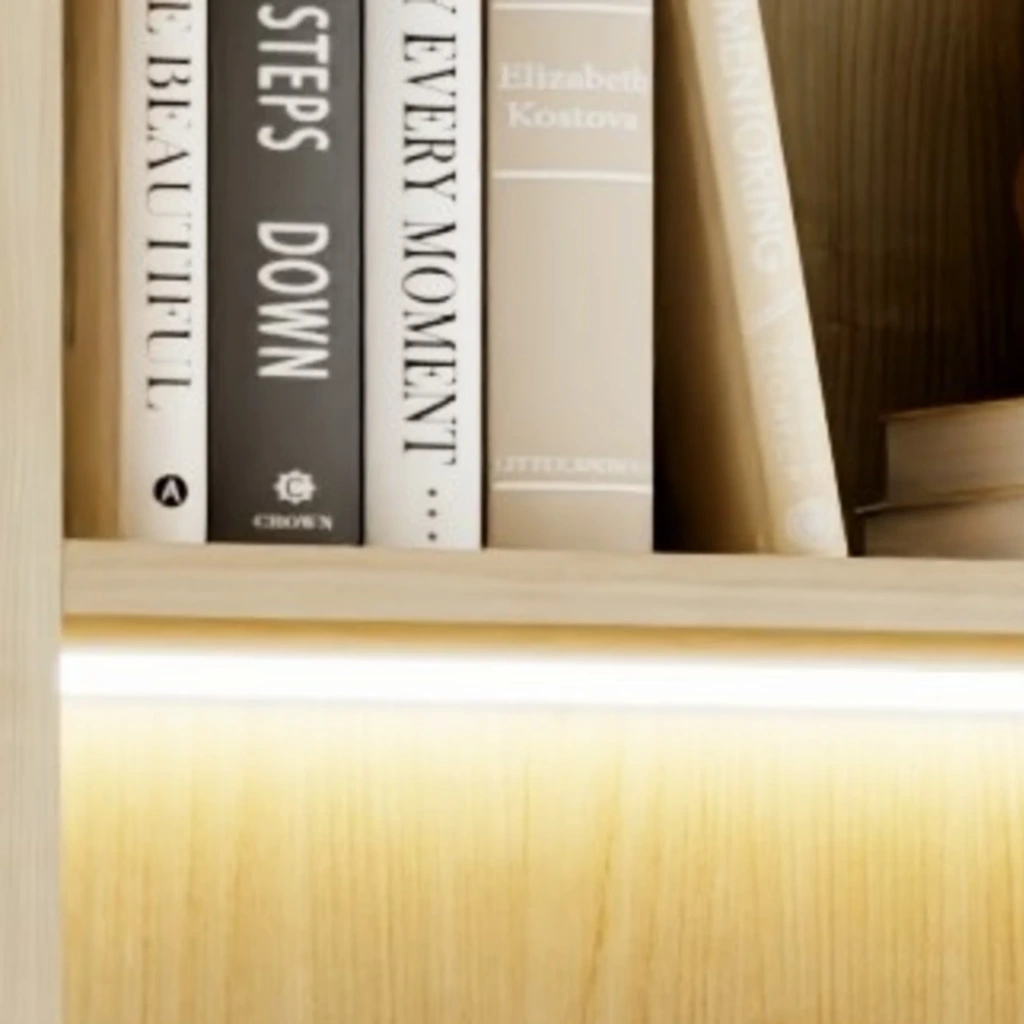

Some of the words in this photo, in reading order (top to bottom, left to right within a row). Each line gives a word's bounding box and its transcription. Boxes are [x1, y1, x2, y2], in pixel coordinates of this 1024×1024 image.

[257, 4, 330, 152] STEPS
[402, 33, 457, 202] EVERY
[499, 61, 648, 97] Elizabeth
[506, 101, 638, 131] Kostova
[714, 0, 791, 273] MENTORING
[146, 56, 192, 411] BEAUTIFUL
[257, 222, 330, 379] DOWN
[401, 220, 458, 465] MOMENT
[252, 513, 333, 531] CROWN
